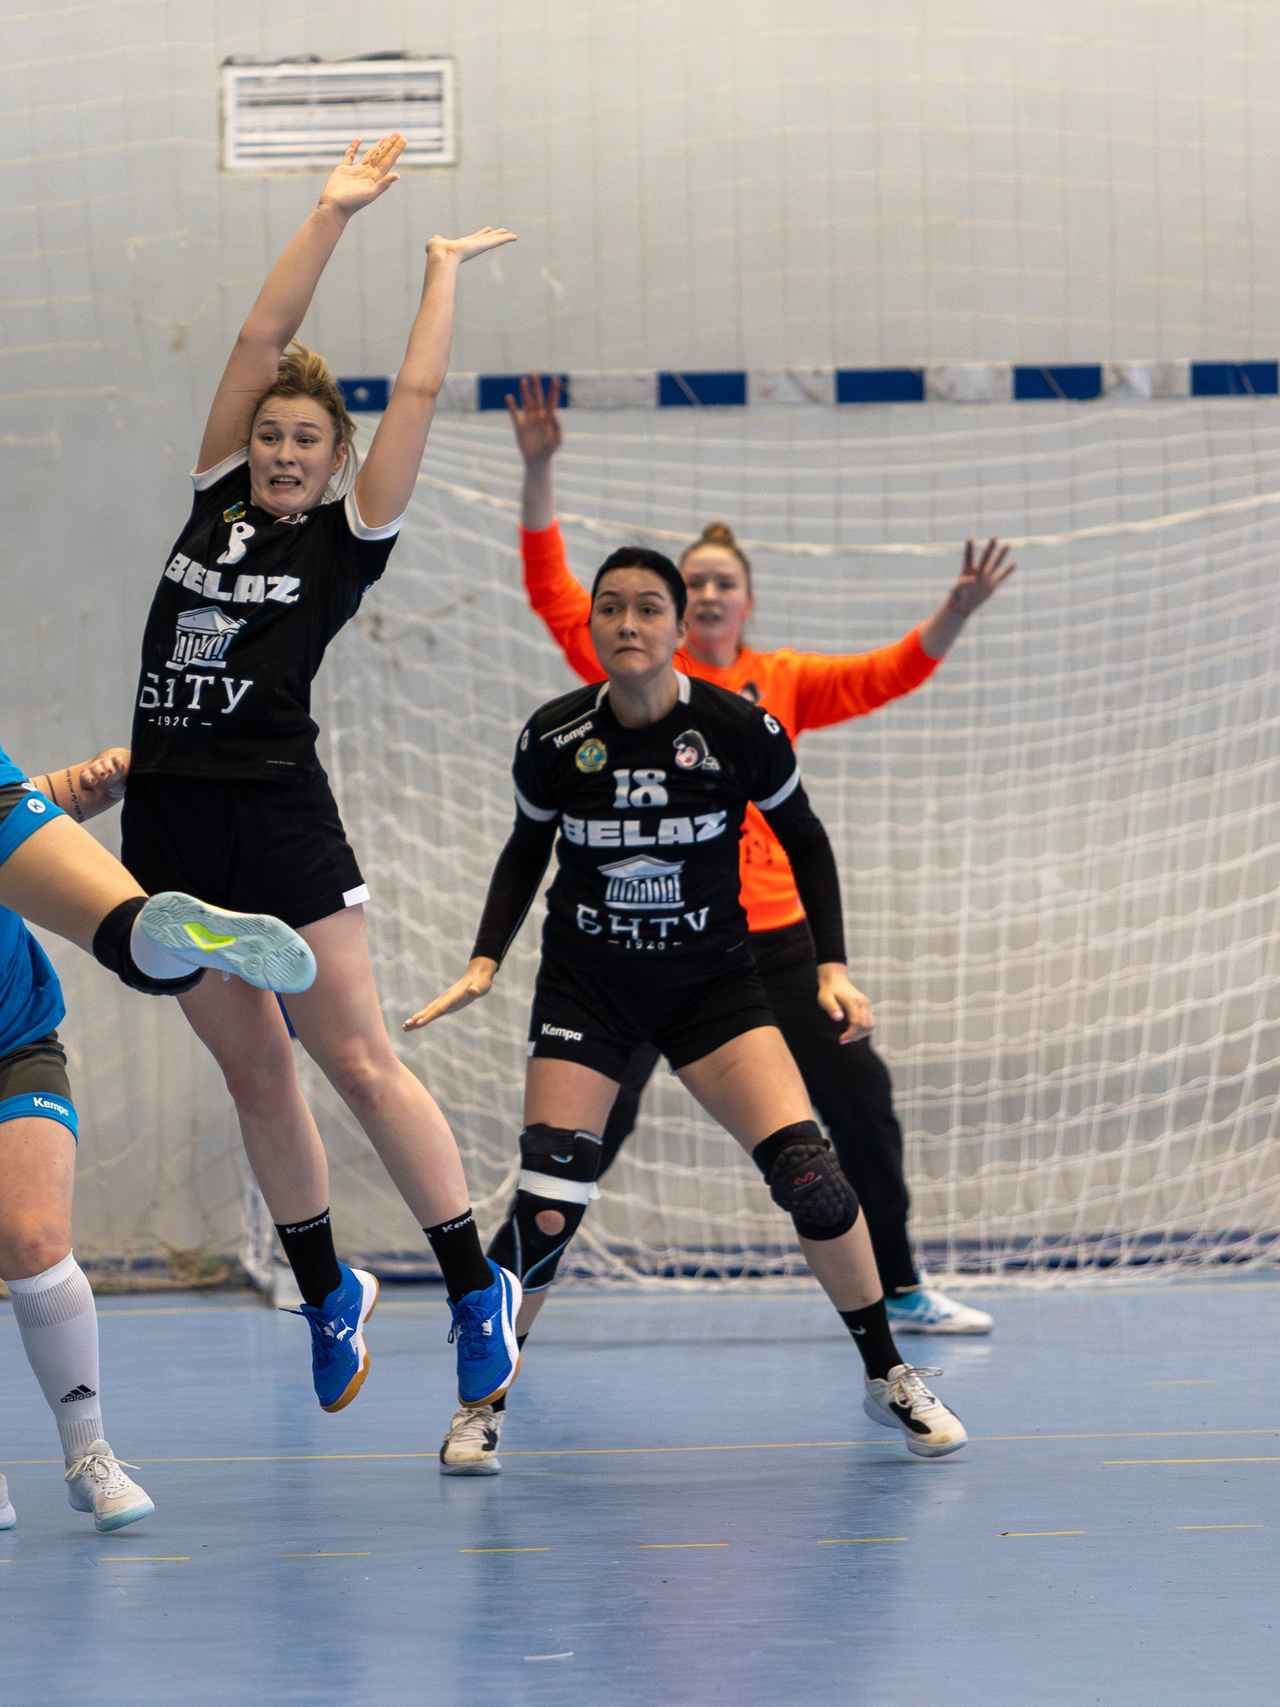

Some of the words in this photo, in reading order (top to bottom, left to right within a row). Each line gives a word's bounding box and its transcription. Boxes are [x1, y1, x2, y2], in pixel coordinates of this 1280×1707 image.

[217, 522, 256, 564] 8
[164, 552, 301, 604] BELAZ
[553, 720, 593, 748] Kempa
[613, 768, 669, 809] 18
[561, 810, 727, 848] BELAZ
[541, 1022, 583, 1042] Kempa
[33, 1097, 69, 1117] Kempa
[60, 1391, 96, 1403] adidas
